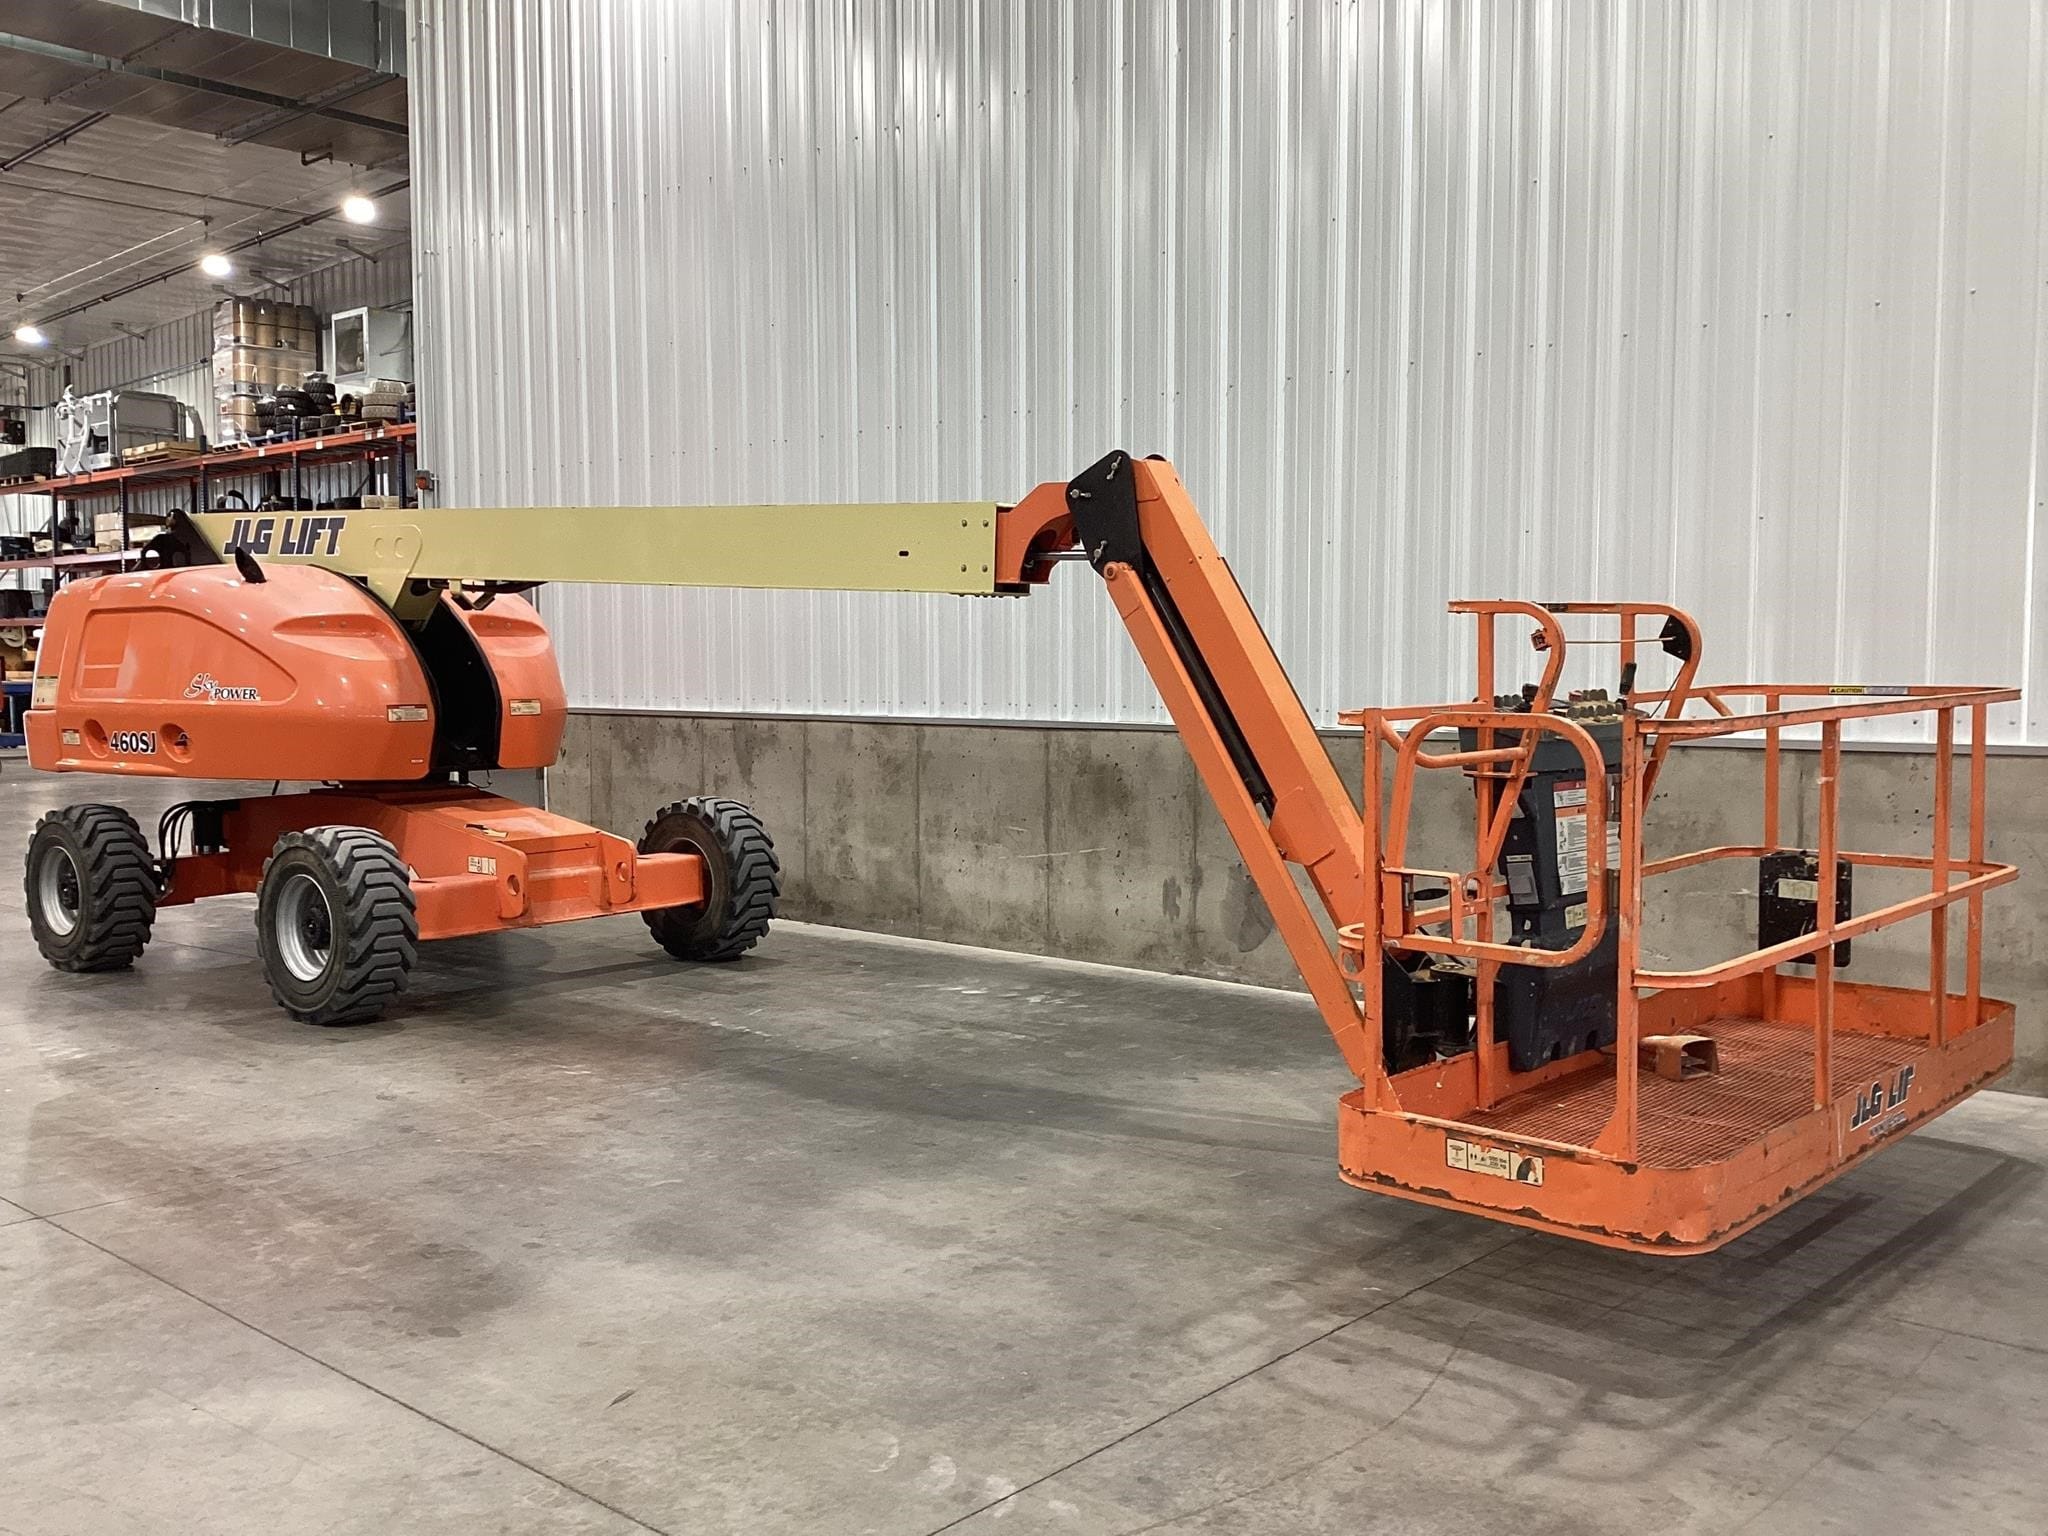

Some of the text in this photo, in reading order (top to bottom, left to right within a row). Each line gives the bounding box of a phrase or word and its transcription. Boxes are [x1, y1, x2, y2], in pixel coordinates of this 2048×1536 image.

[223, 517, 347, 555] JLG LIFT
[213, 688, 257, 700] POWER
[110, 731, 156, 754] 460SJ
[1850, 1081, 1882, 1130] JLG
